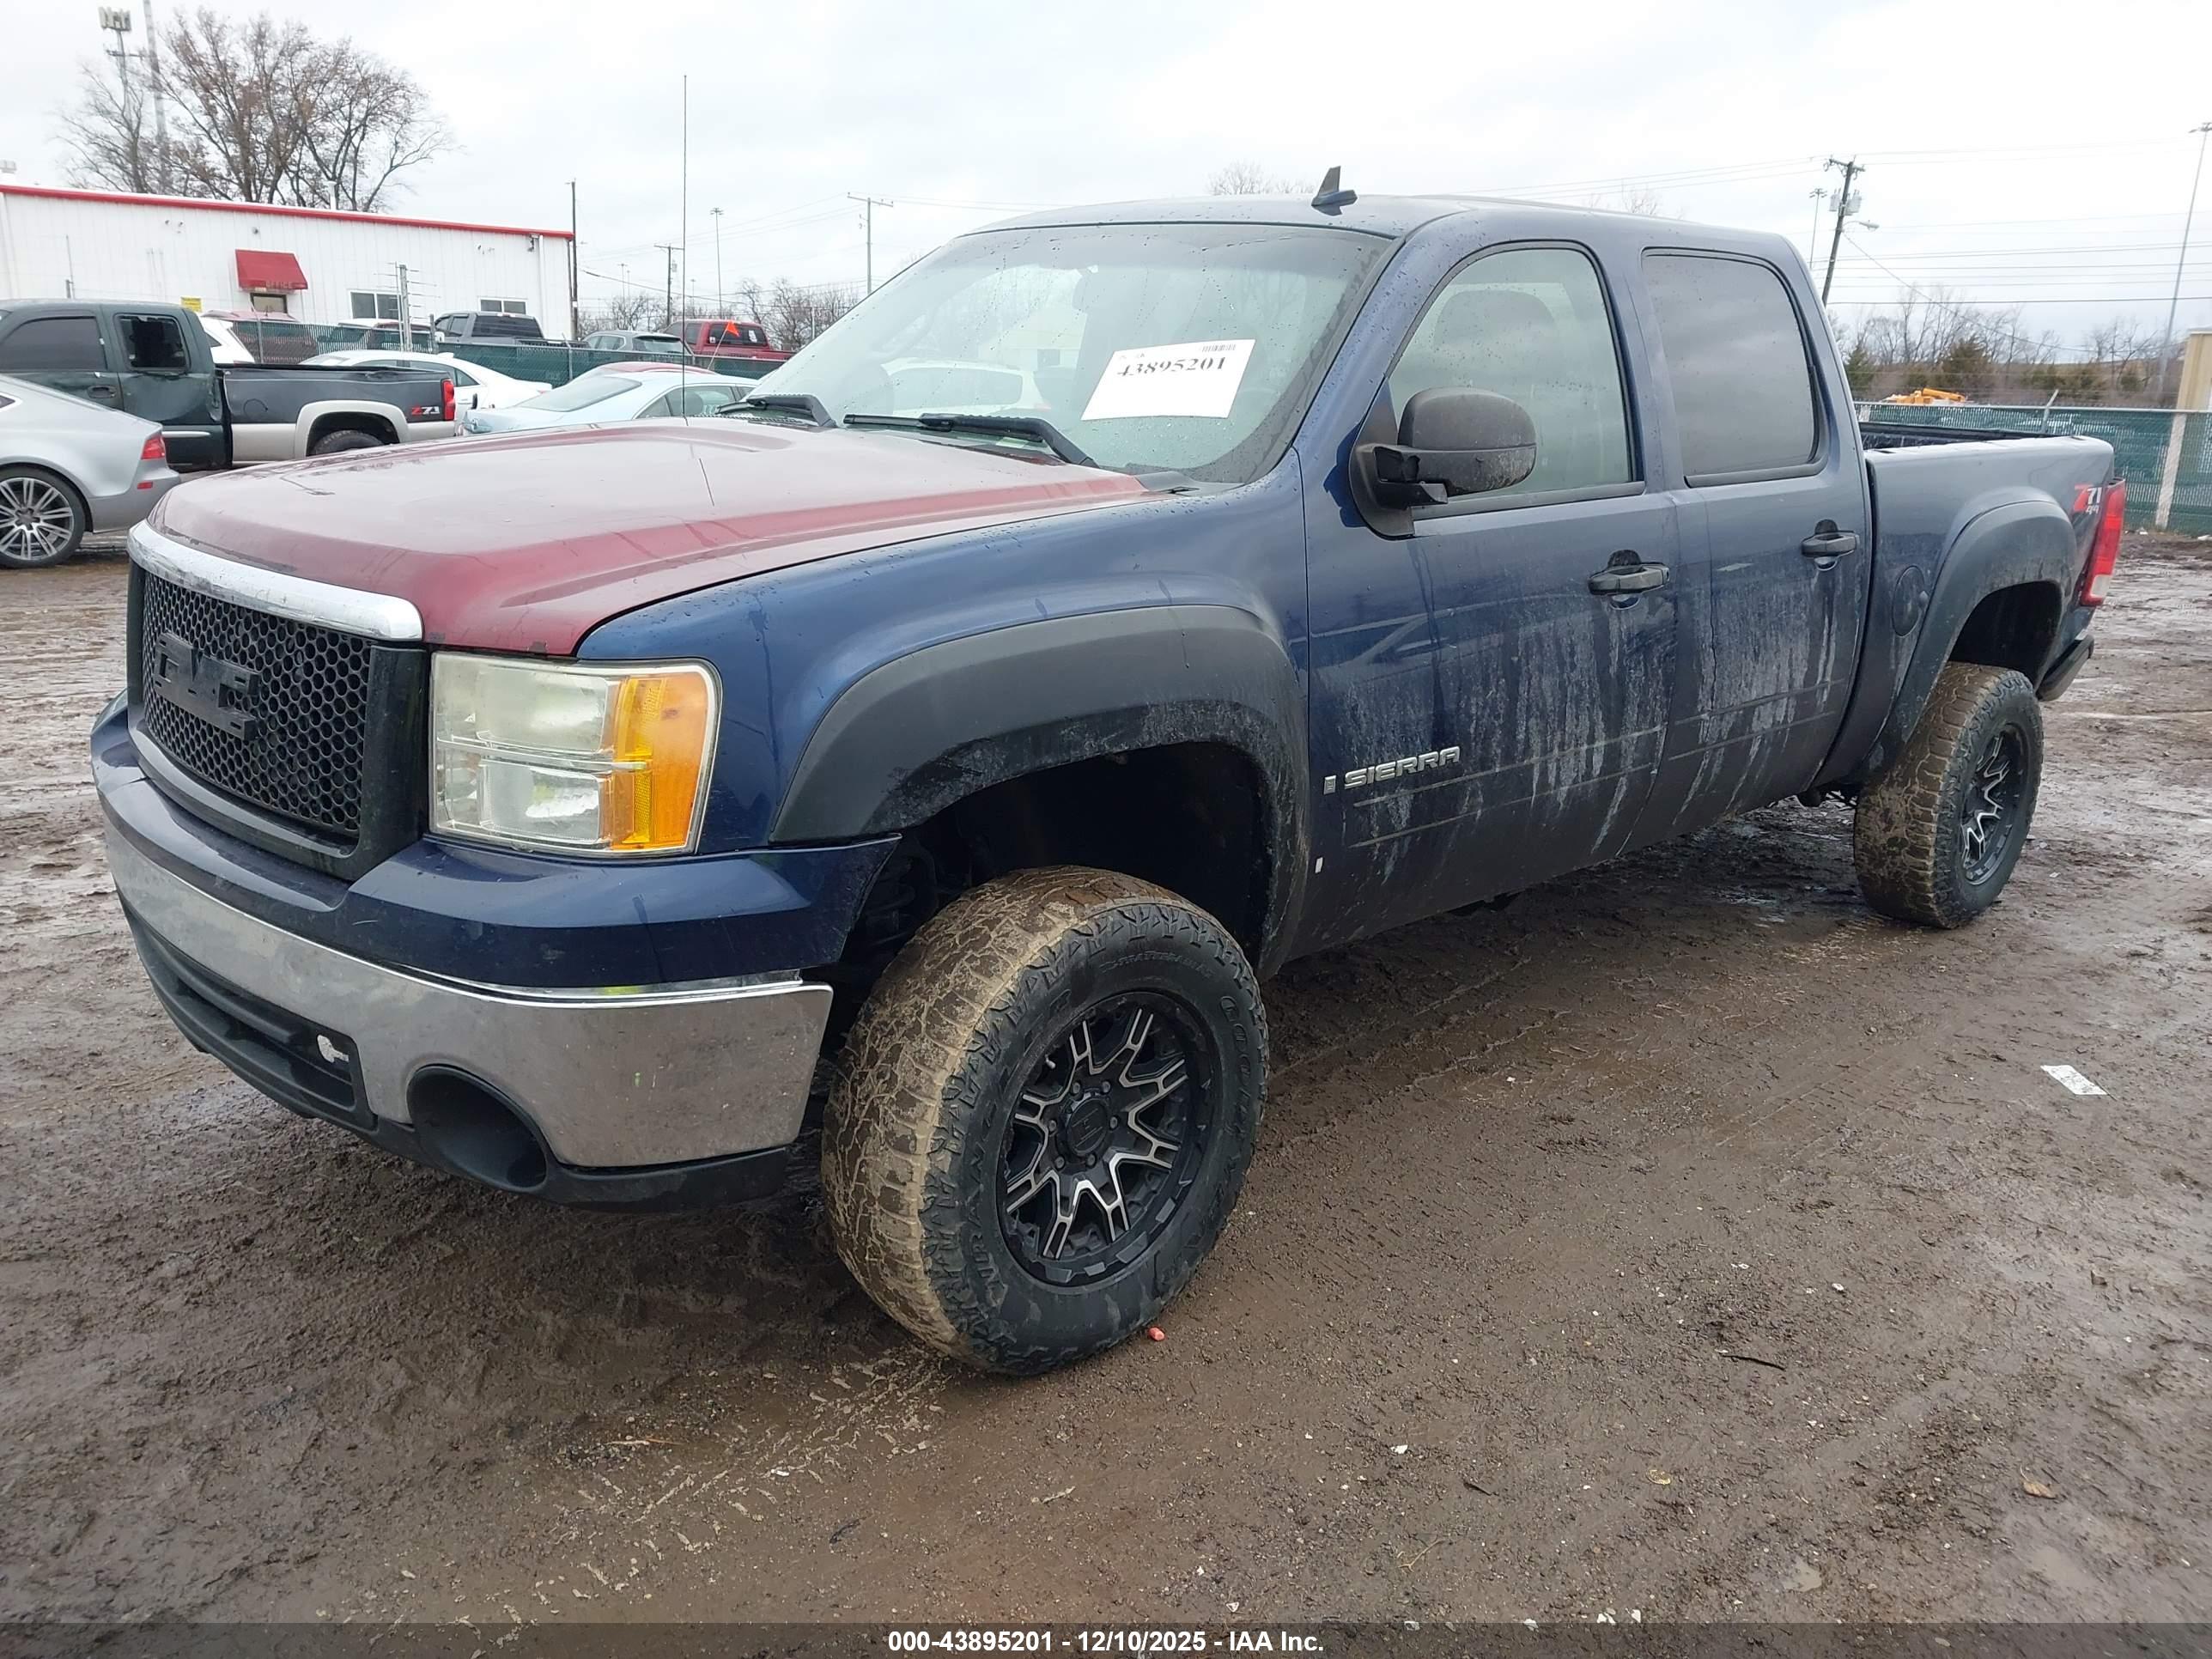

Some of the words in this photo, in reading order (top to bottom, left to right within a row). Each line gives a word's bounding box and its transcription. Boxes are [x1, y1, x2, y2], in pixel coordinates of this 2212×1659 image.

[266, 281, 293, 289] OFFICE
[1117, 356, 1226, 376] 43895201
[411, 405, 440, 415] Z71
[2073, 483, 2103, 512] Z71
[1344, 745, 1461, 790] SIERRA
